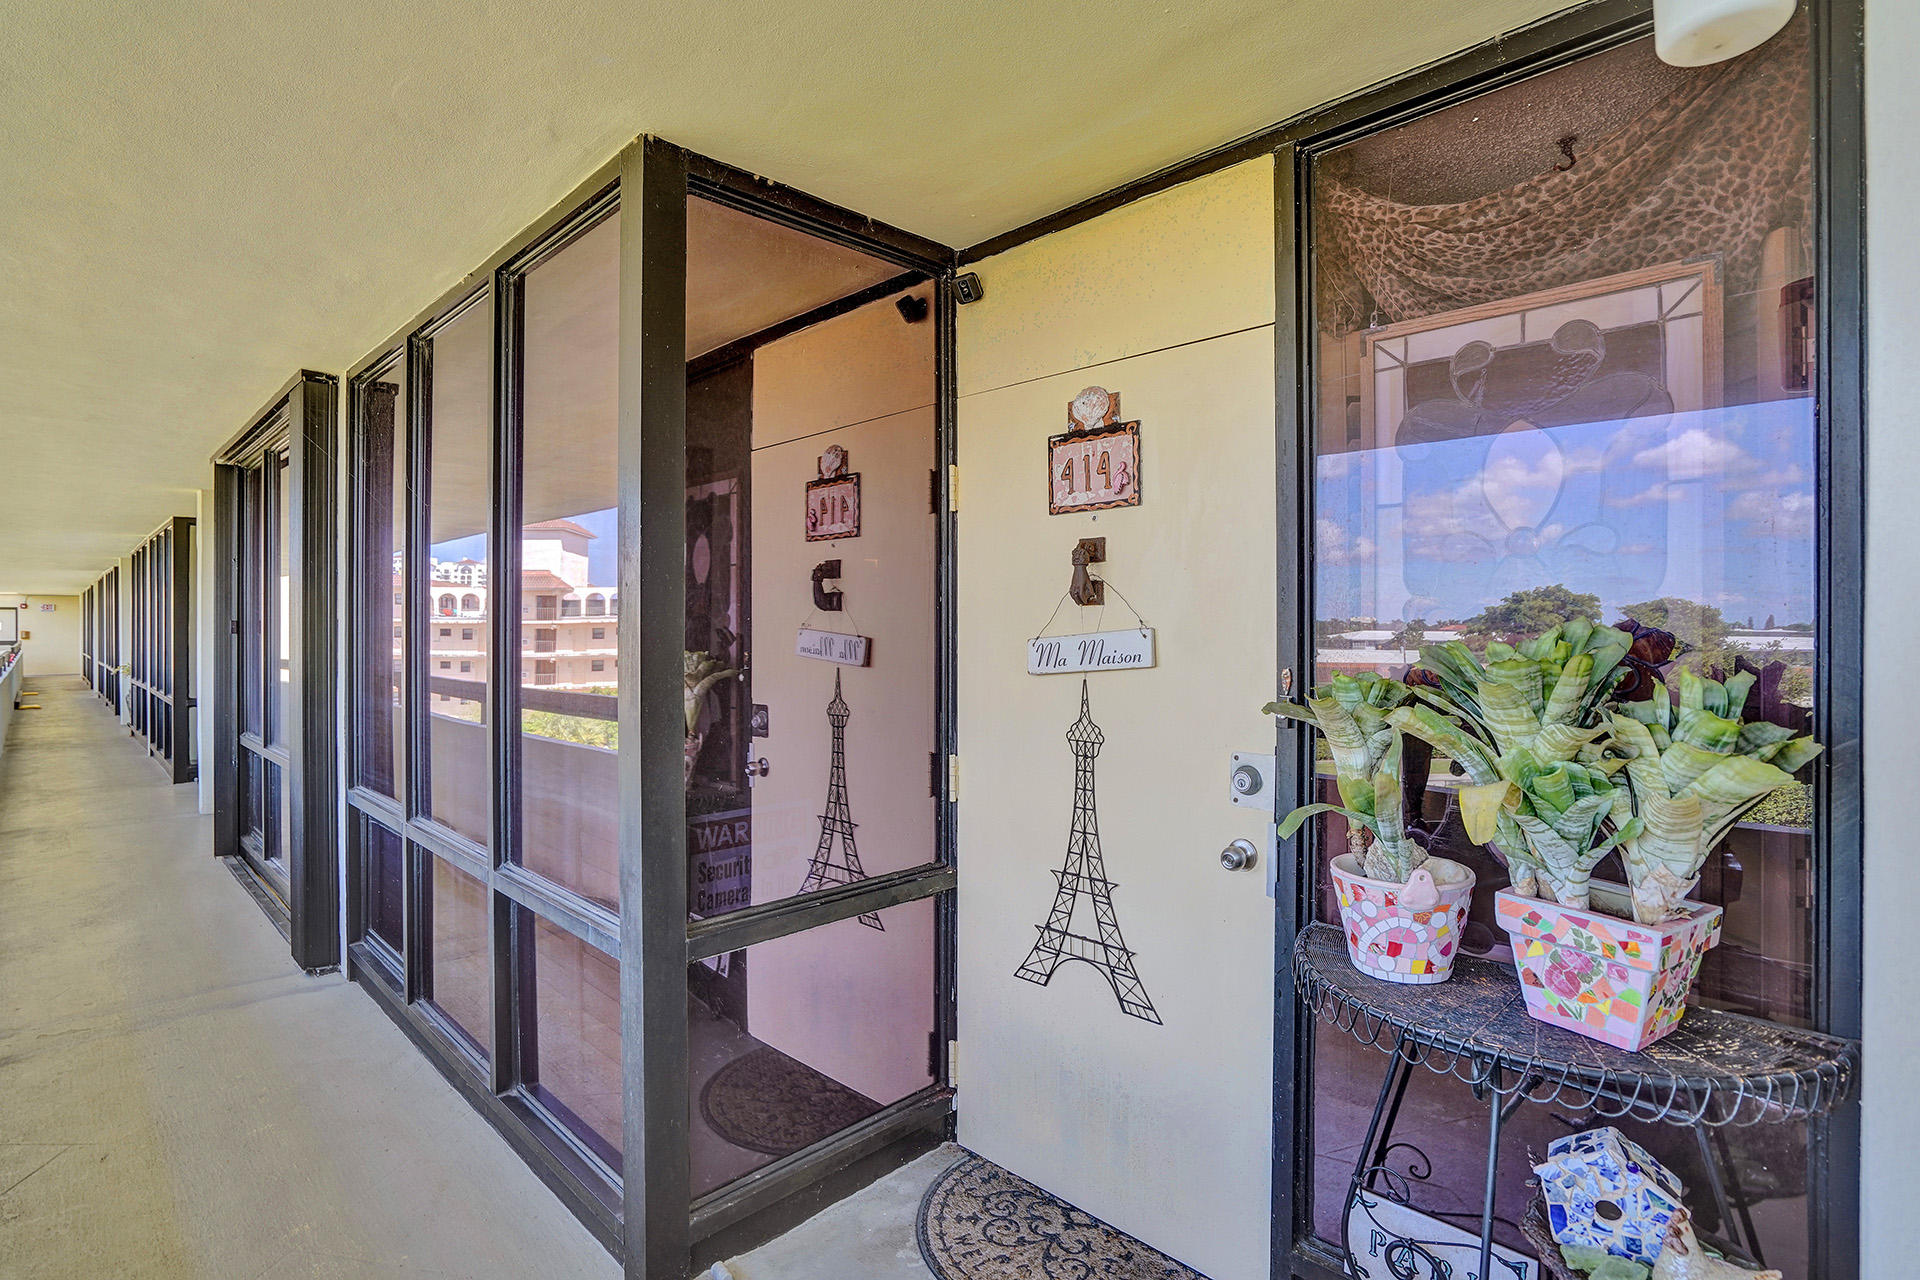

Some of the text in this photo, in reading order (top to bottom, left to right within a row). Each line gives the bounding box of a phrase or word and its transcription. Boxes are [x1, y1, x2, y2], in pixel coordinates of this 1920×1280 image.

[1060, 450, 1112, 495] 414
[1035, 638, 1143, 668] Ma Maison
[697, 885, 751, 913] Camera
